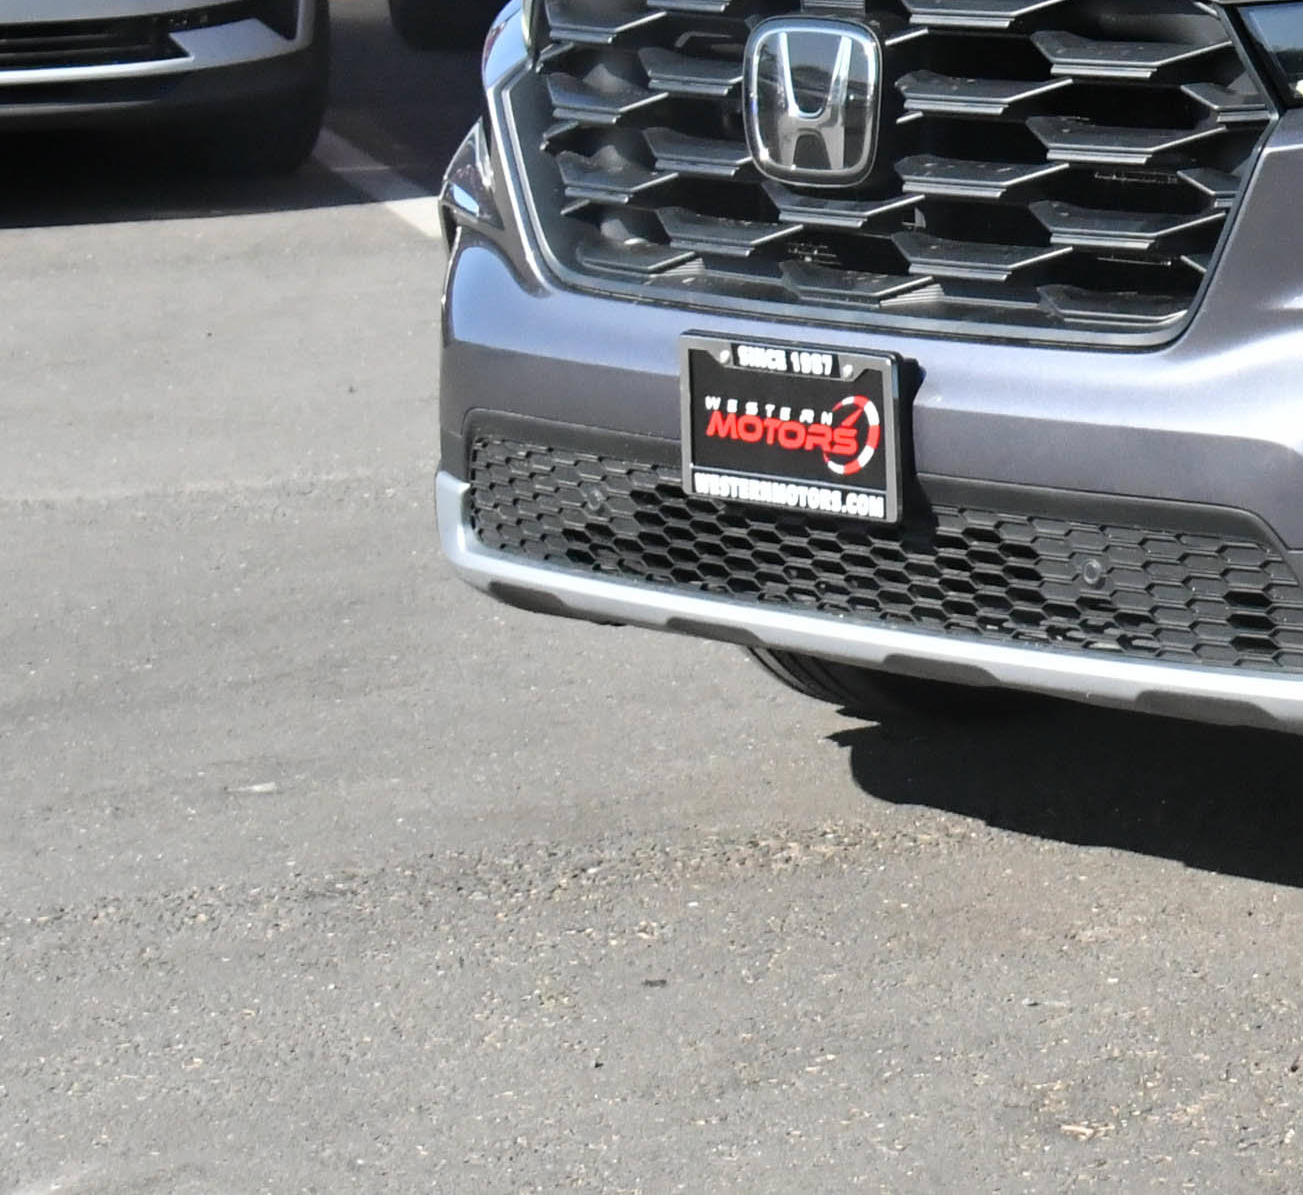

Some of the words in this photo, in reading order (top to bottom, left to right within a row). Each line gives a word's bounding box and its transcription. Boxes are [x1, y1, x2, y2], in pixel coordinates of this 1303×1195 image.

[705, 396, 833, 426] WESTERN
[706, 410, 858, 456] MOTORS
[694, 472, 885, 518] WESTERNMOTORS.COM
